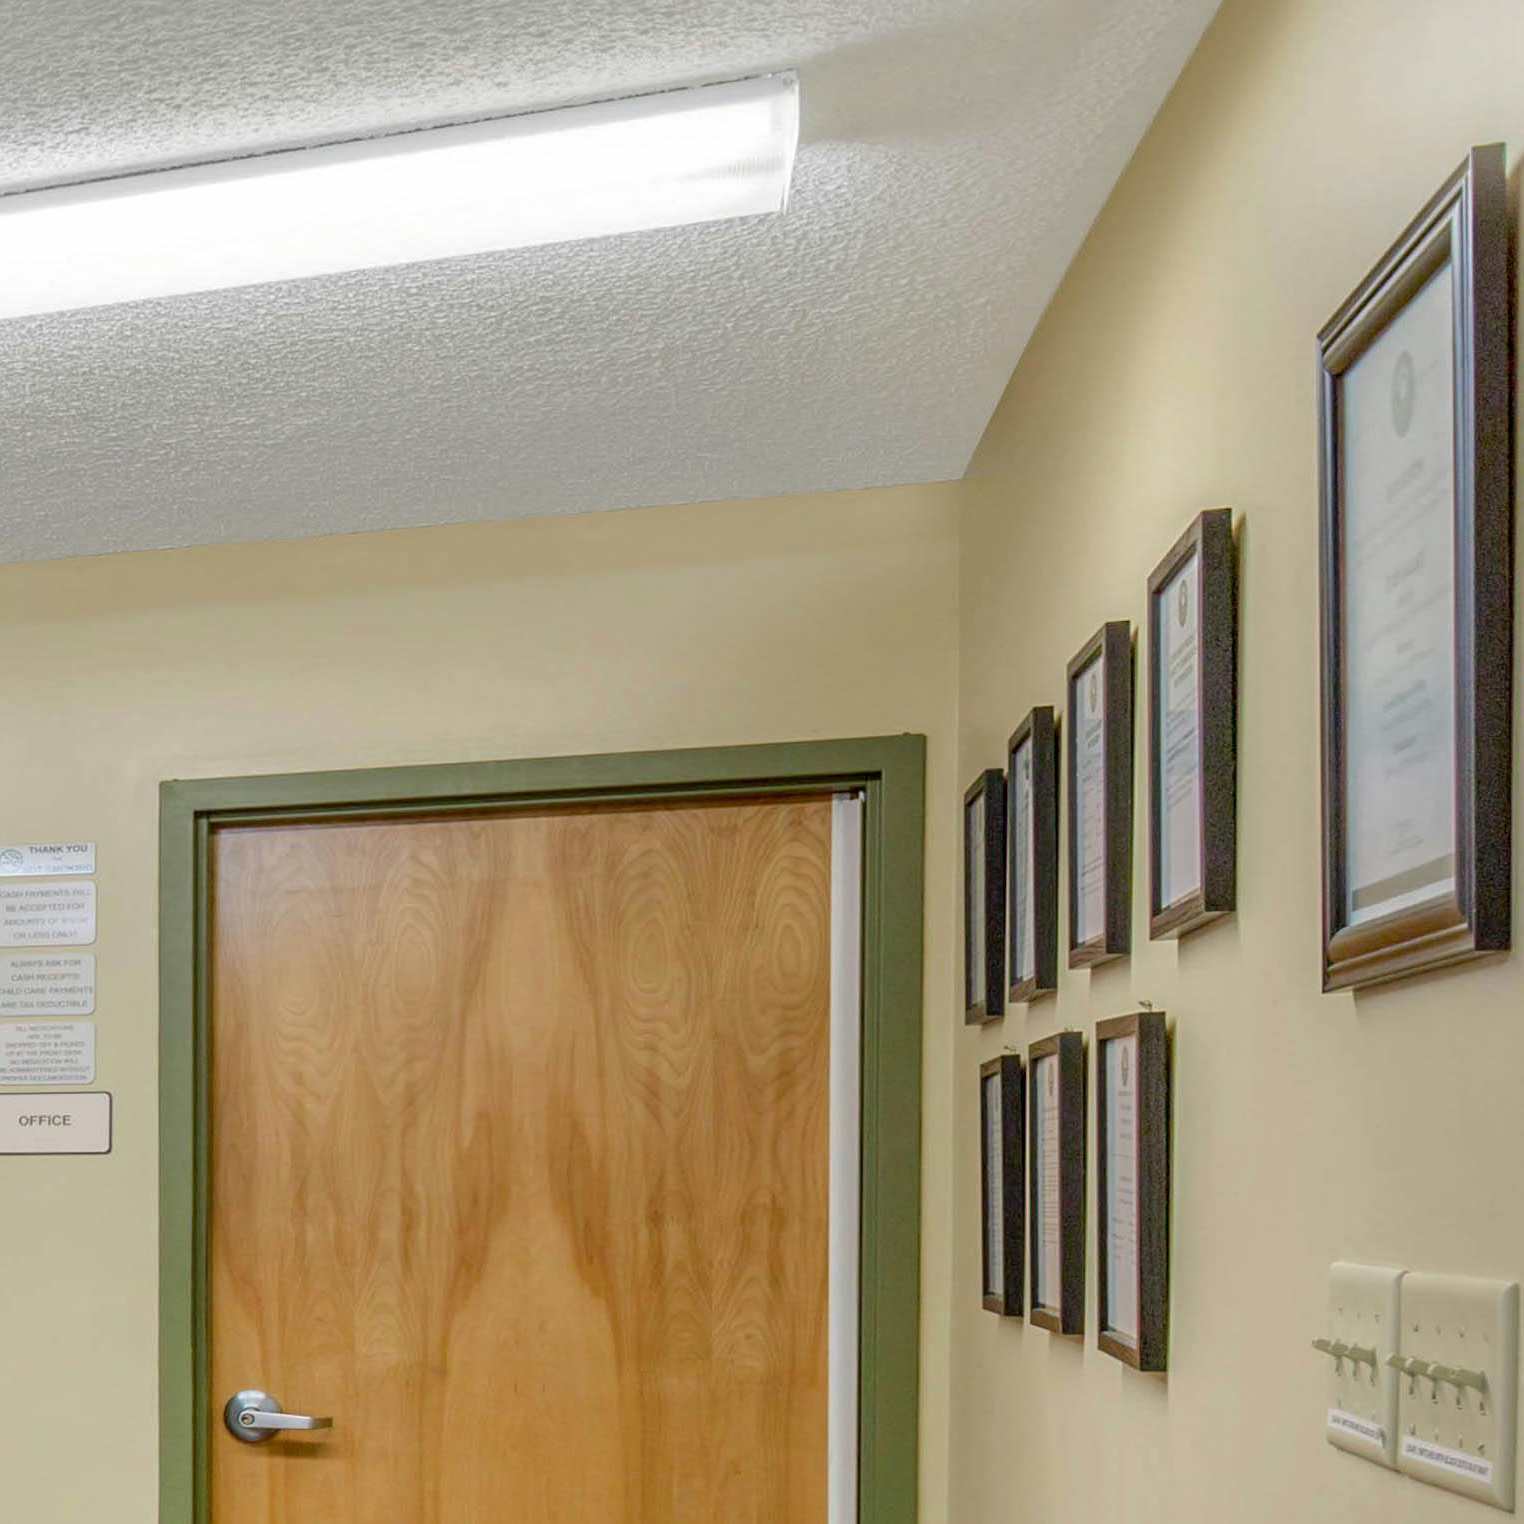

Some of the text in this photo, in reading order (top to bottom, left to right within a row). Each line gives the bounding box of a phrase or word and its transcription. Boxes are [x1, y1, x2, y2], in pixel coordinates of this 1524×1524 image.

[29, 844, 88, 855] THANK YOU
[18, 1115, 72, 1127] OFFICE
